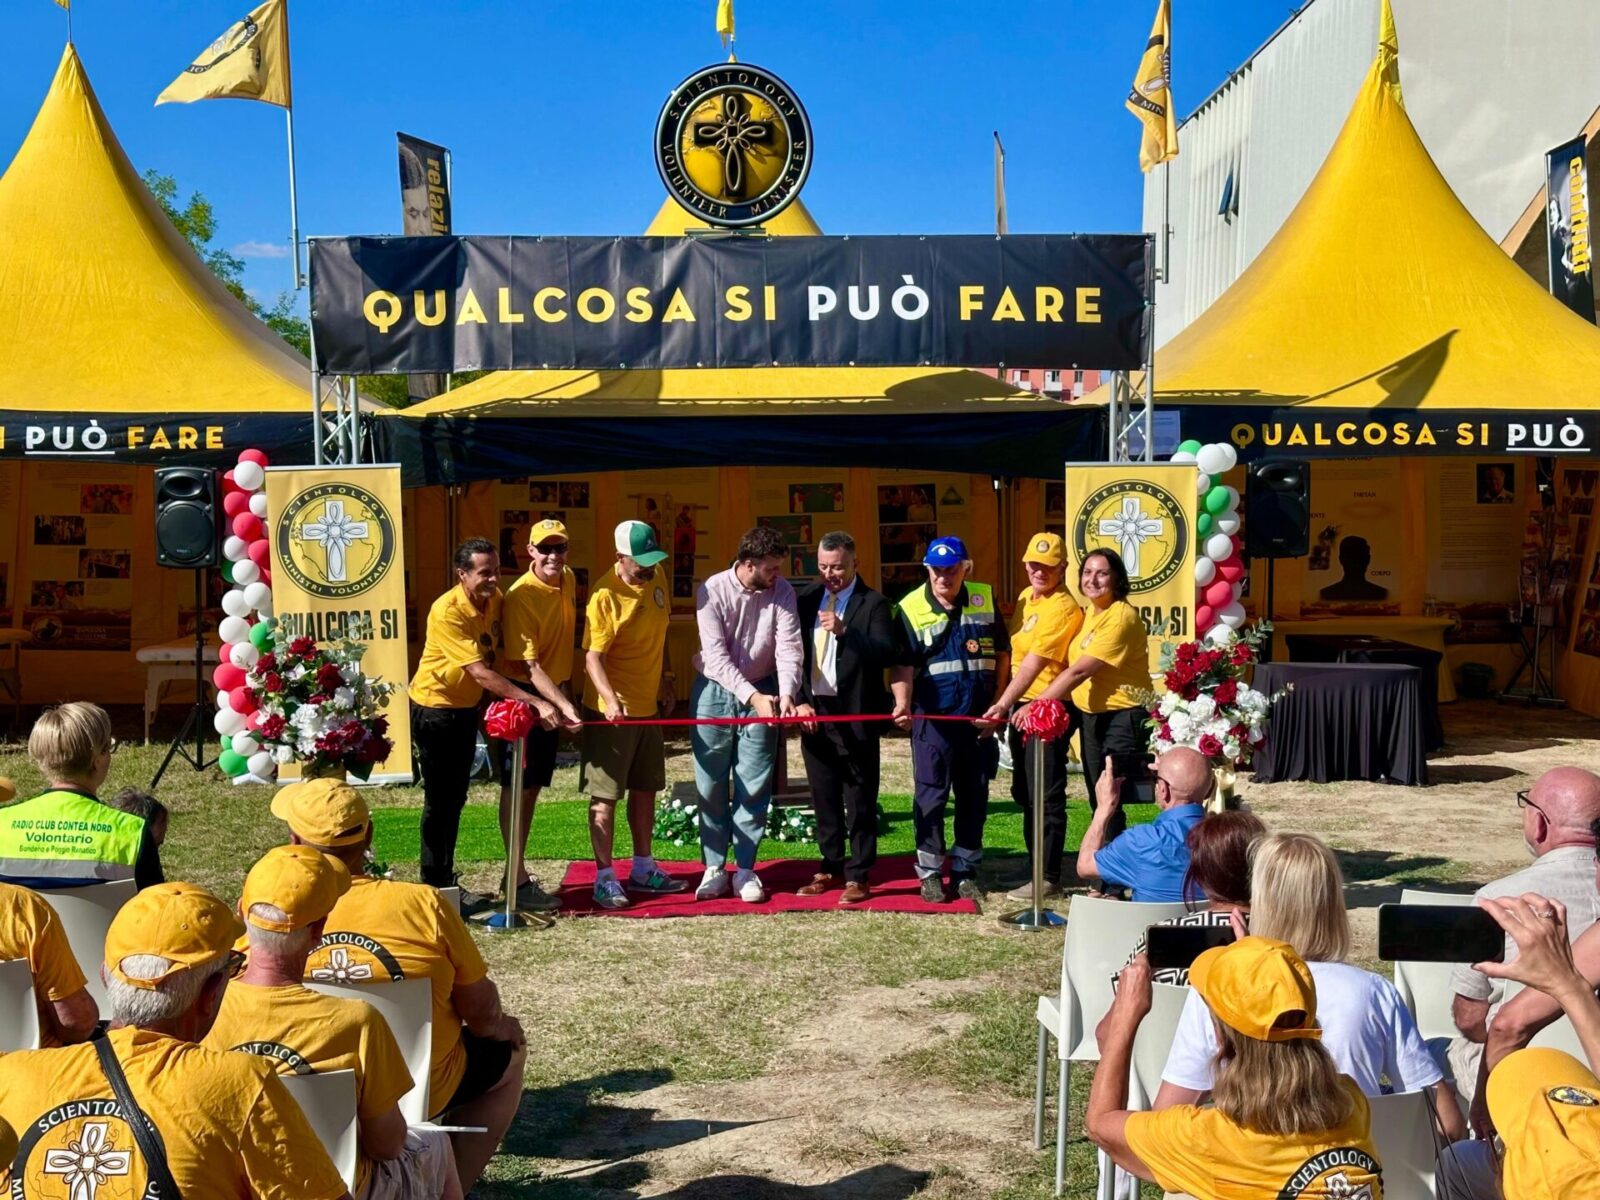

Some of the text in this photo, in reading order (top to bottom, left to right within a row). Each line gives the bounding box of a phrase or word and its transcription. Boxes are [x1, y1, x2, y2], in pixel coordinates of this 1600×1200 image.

[669, 71, 797, 120] SCIENTOLOGY
[663, 140, 805, 218] VOLUNTEER MINISTER
[427, 158, 448, 236] relazi
[363, 274, 1102, 333] QUALCOSA SI PUÒ FARE
[25, 419, 108, 450] PUÒ
[127, 426, 224, 449] FARE
[1231, 417, 1585, 449] QUALCOSA SI PUÒ
[283, 486, 387, 526] SCIENTOLOGY
[1080, 484, 1182, 521] SCIENTOLOGY
[282, 554, 387, 595] MINISTRI VOLONTARI
[1130, 559, 1180, 590] OLONTARI
[380, 609, 398, 640] SI
[1170, 606, 1187, 636] SI
[11, 820, 112, 832] RADIO CLUB CONTEA NORD
[26, 832, 93, 844] Volontario
[308, 933, 380, 954] NTOLOGY
[38, 1101, 154, 1133] SCIENTOL
[1286, 1150, 1373, 1197] SCIENTOLOGY
